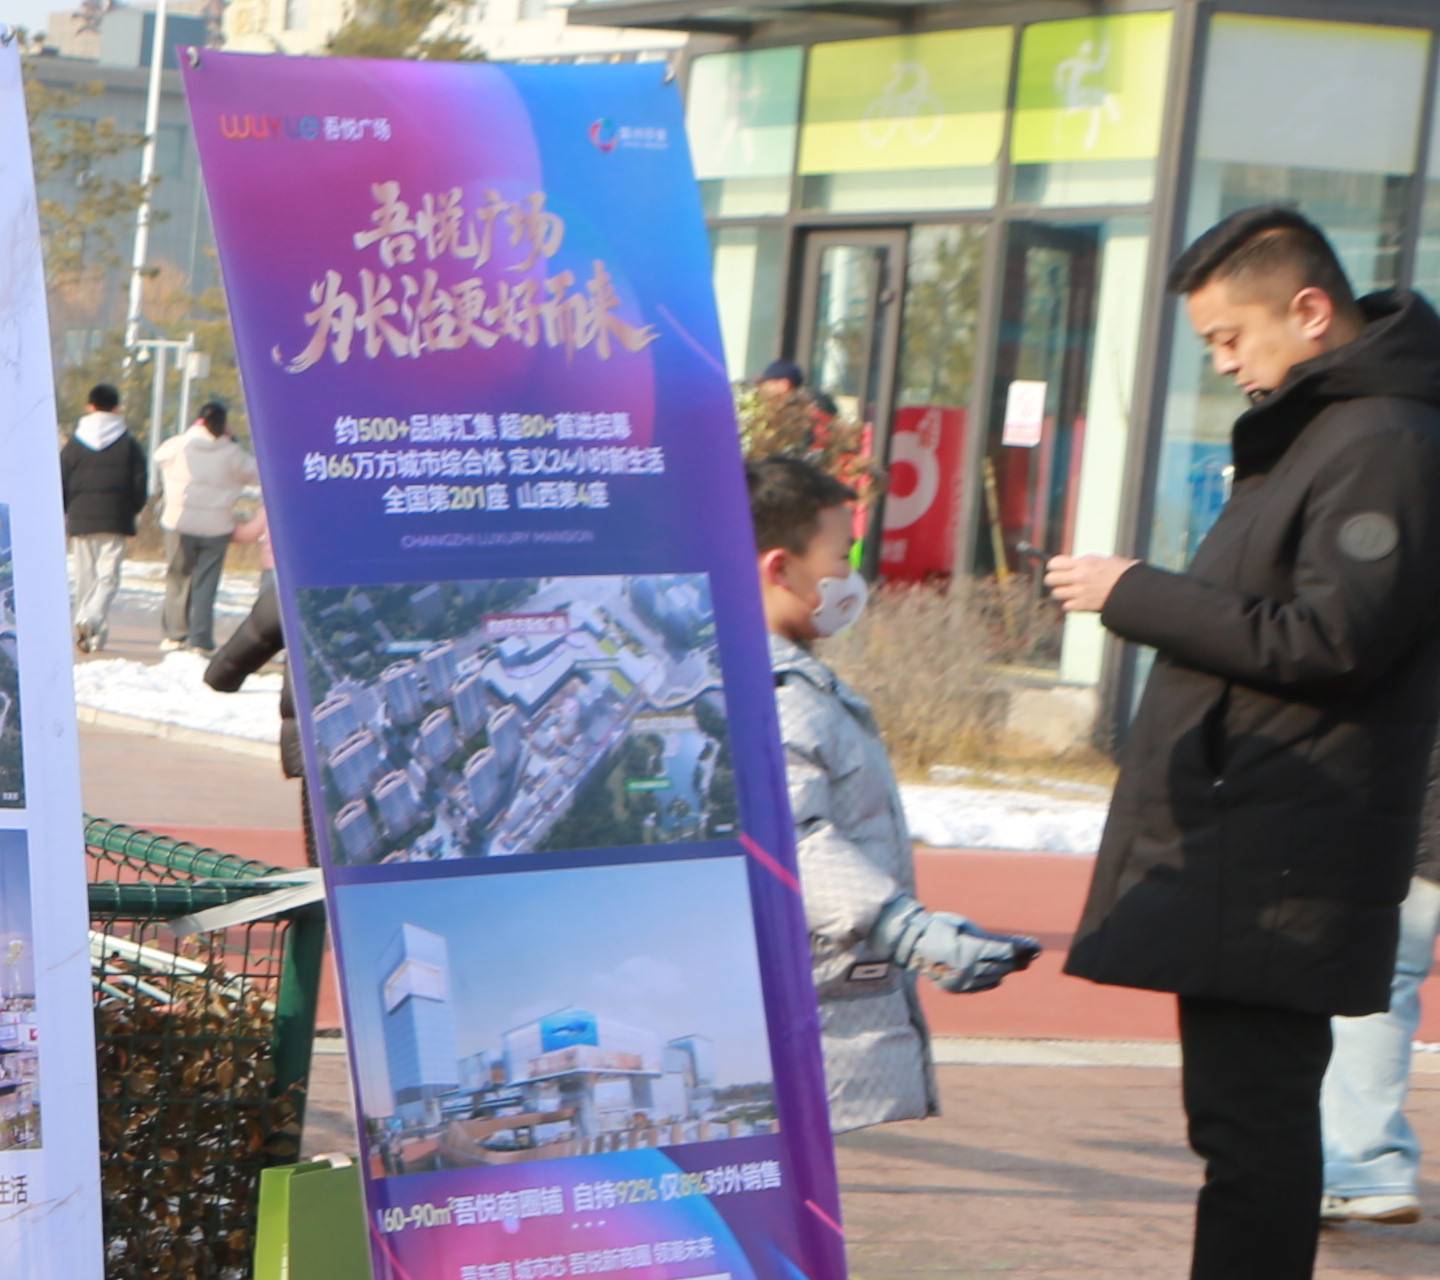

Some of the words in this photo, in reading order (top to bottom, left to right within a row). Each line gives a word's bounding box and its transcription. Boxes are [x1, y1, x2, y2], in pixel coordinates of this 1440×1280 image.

[323, 114, 392, 143] 吾悦广场
[353, 179, 566, 272] 吾悦广场
[271, 257, 664, 375] 为长治更好而来
[334, 413, 497, 446] 约500+品牌汇集
[303, 448, 508, 482] 约66万方城市综合体
[382, 484, 510, 515] 全国第201座
